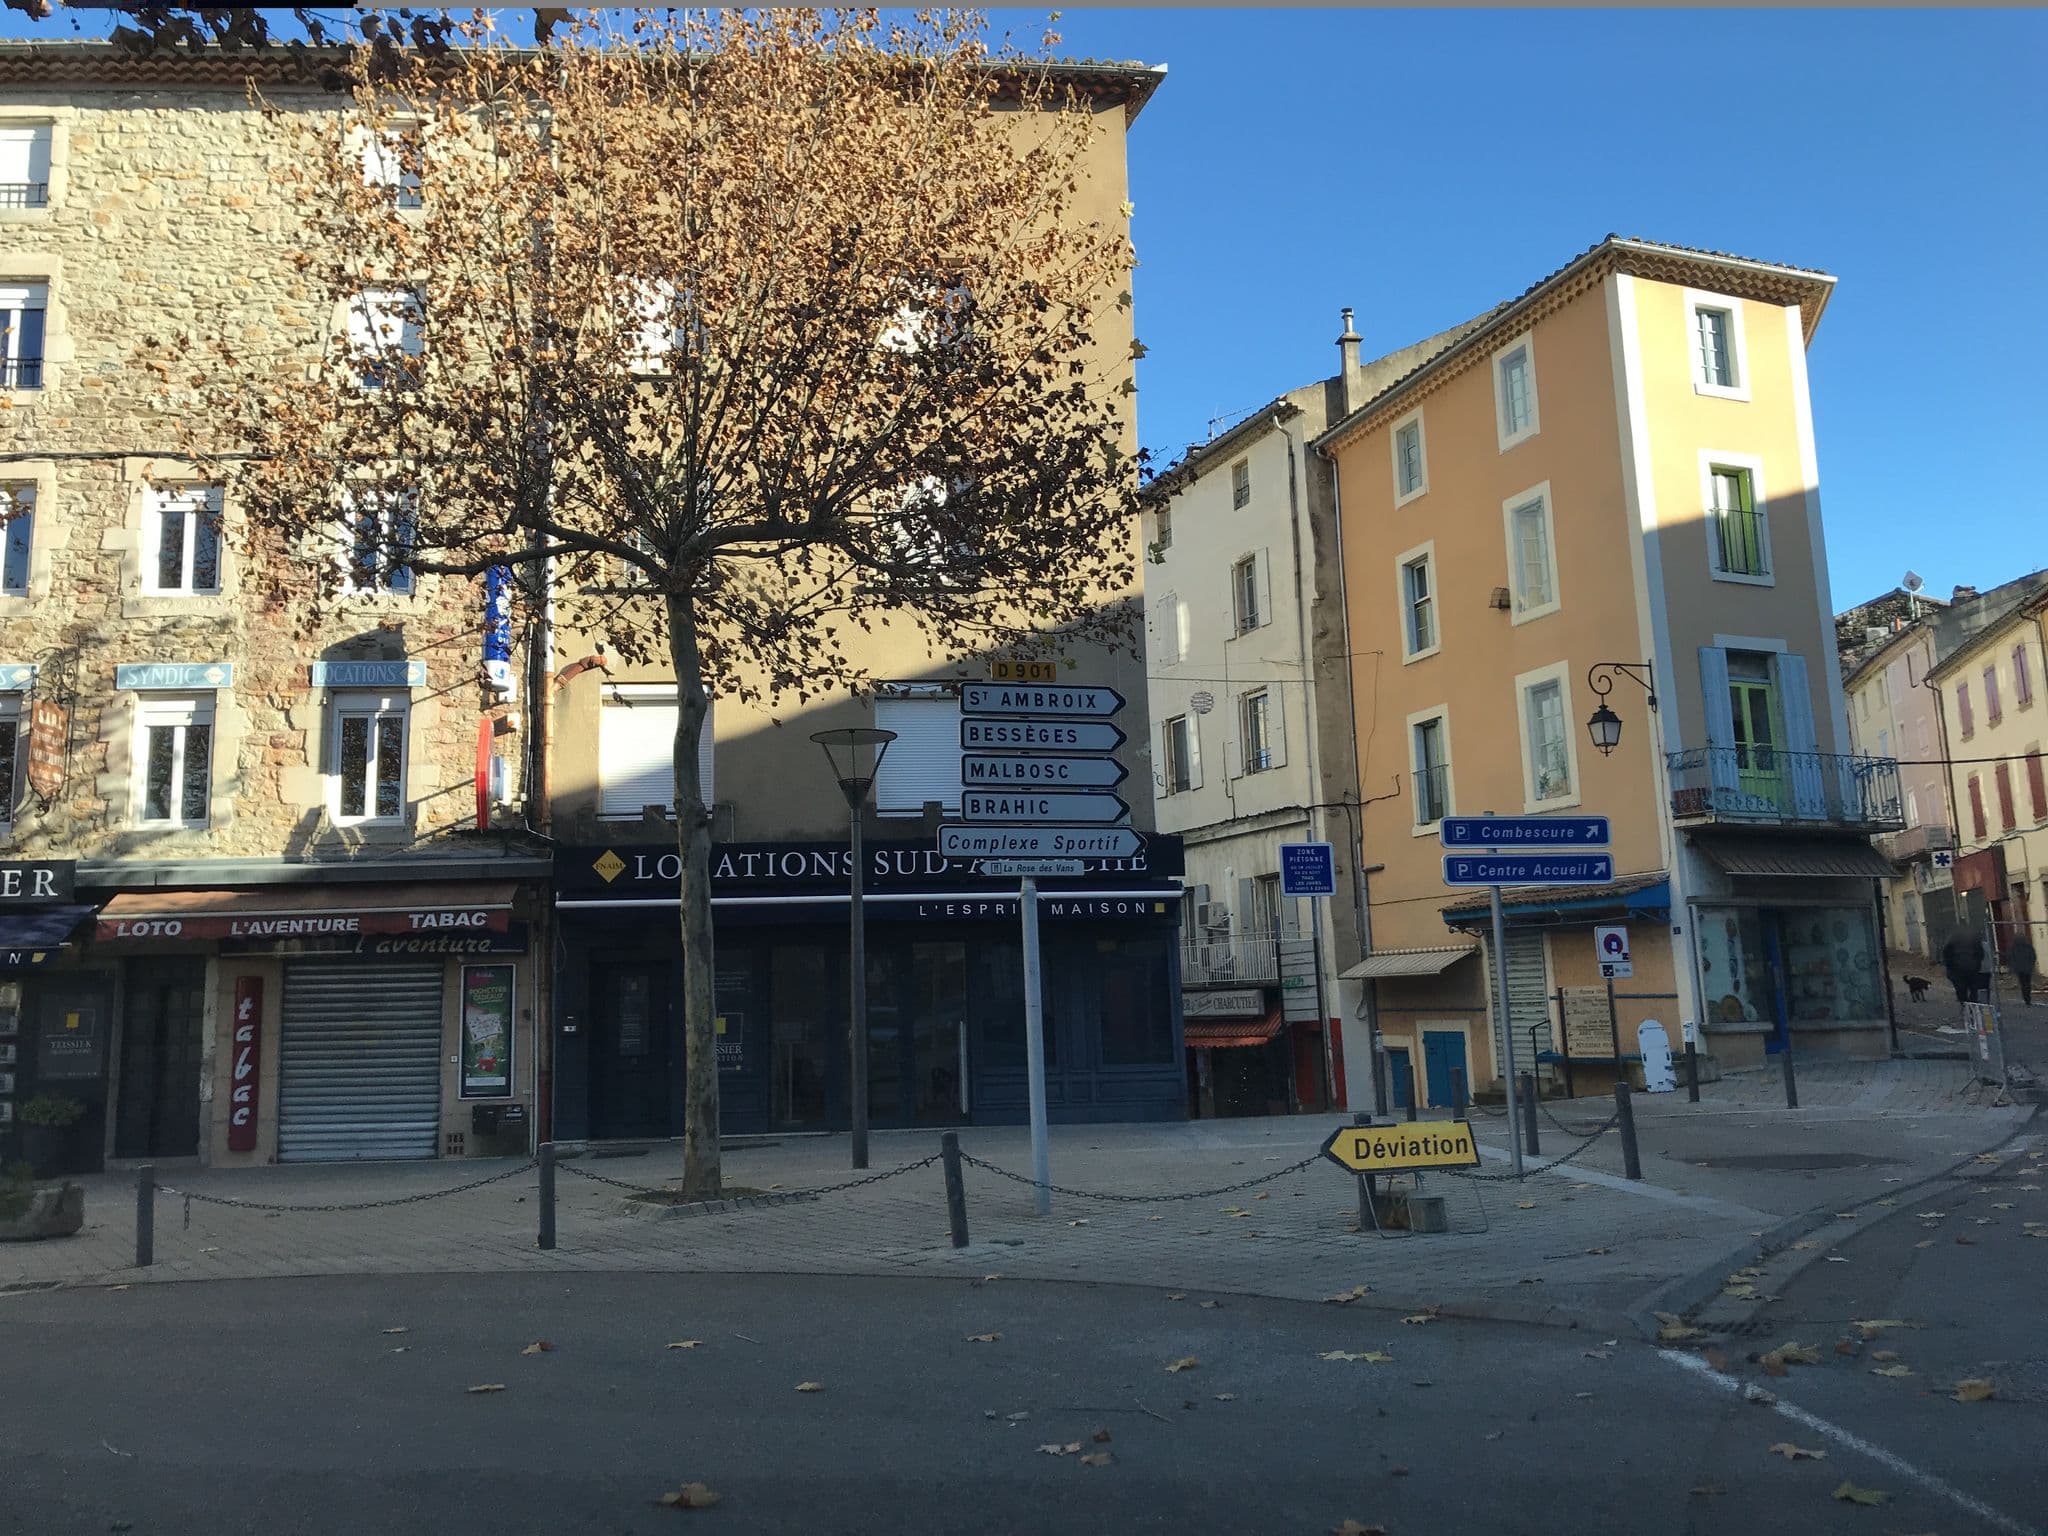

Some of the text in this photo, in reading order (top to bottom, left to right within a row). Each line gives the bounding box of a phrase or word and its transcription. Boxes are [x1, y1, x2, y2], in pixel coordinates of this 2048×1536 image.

[125, 666, 198, 685] SYNDIC
[316, 663, 399, 682] LOCATIONS
[998, 663, 1052, 679] D 901
[1001, 692, 1097, 709] AMBROIX
[969, 725, 1077, 744] BESSÈGES
[970, 763, 1070, 779] MALBOSC
[971, 799, 1050, 815] BRAHIC
[1481, 826, 1575, 839] Combescure
[947, 834, 1121, 854] Complexe Sportif
[634, 851, 853, 880] LOATIONS
[1003, 862, 1075, 873] La Rose des Vans
[1478, 864, 1526, 877] Centre
[1533, 863, 1587, 876] Accueil
[919, 902, 1146, 916] L'ESPRI MAISON
[117, 912, 488, 937] LOTO L'AVENTURE TABAC
[354, 937, 493, 953] laventure
[1213, 996, 1258, 1010] CHARCUTIER
[715, 1045, 743, 1054] SSIER
[233, 996, 255, 1126] tabac
[1353, 1133, 1469, 1161] Déviation
